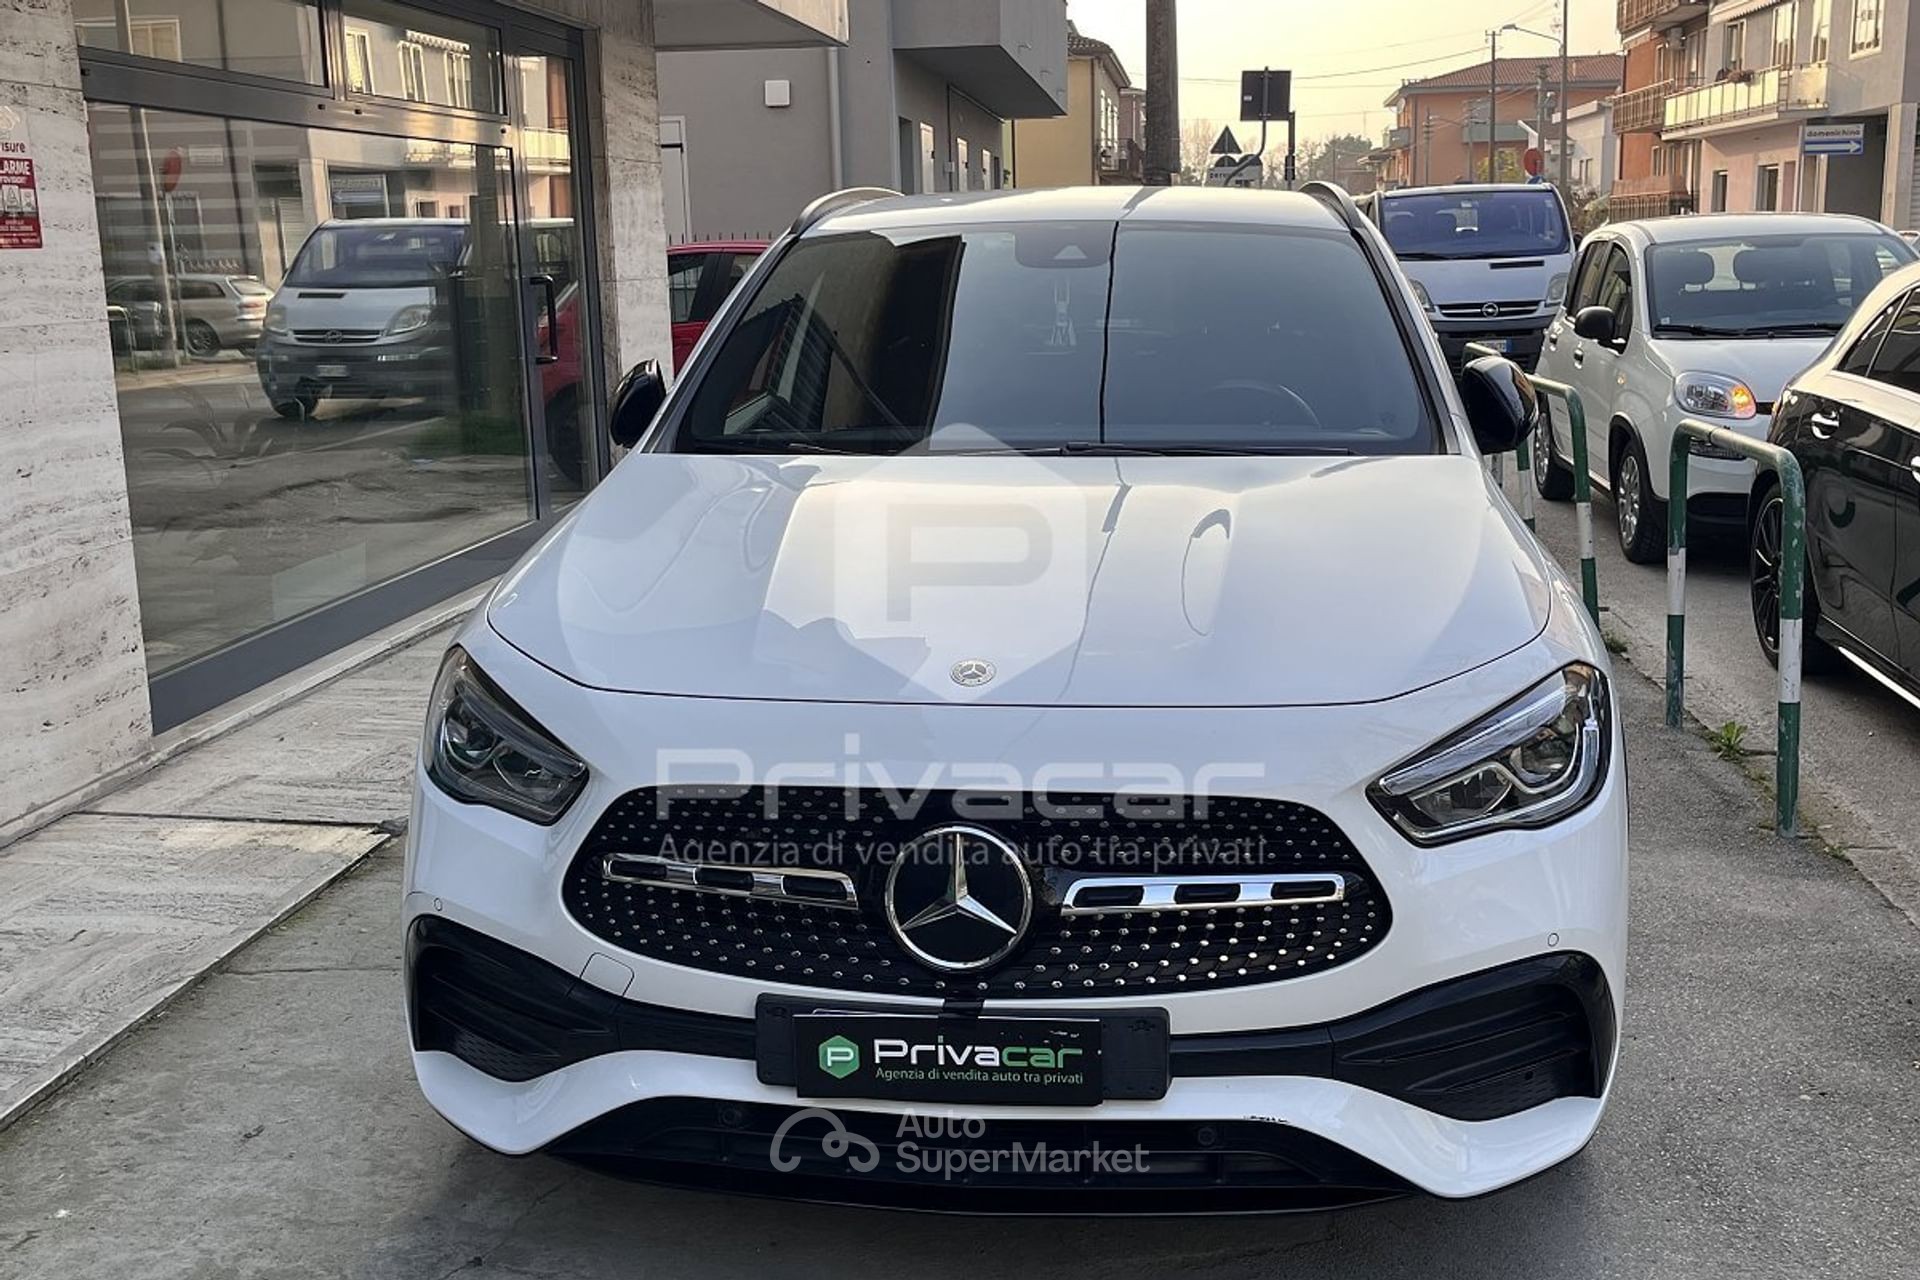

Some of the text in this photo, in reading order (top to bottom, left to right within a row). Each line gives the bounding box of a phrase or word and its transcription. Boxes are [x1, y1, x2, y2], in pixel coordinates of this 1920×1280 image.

[873, 1035, 1083, 1069] Privacar
[875, 1067, 1084, 1085] Agenzia di vendita auto tra privati
